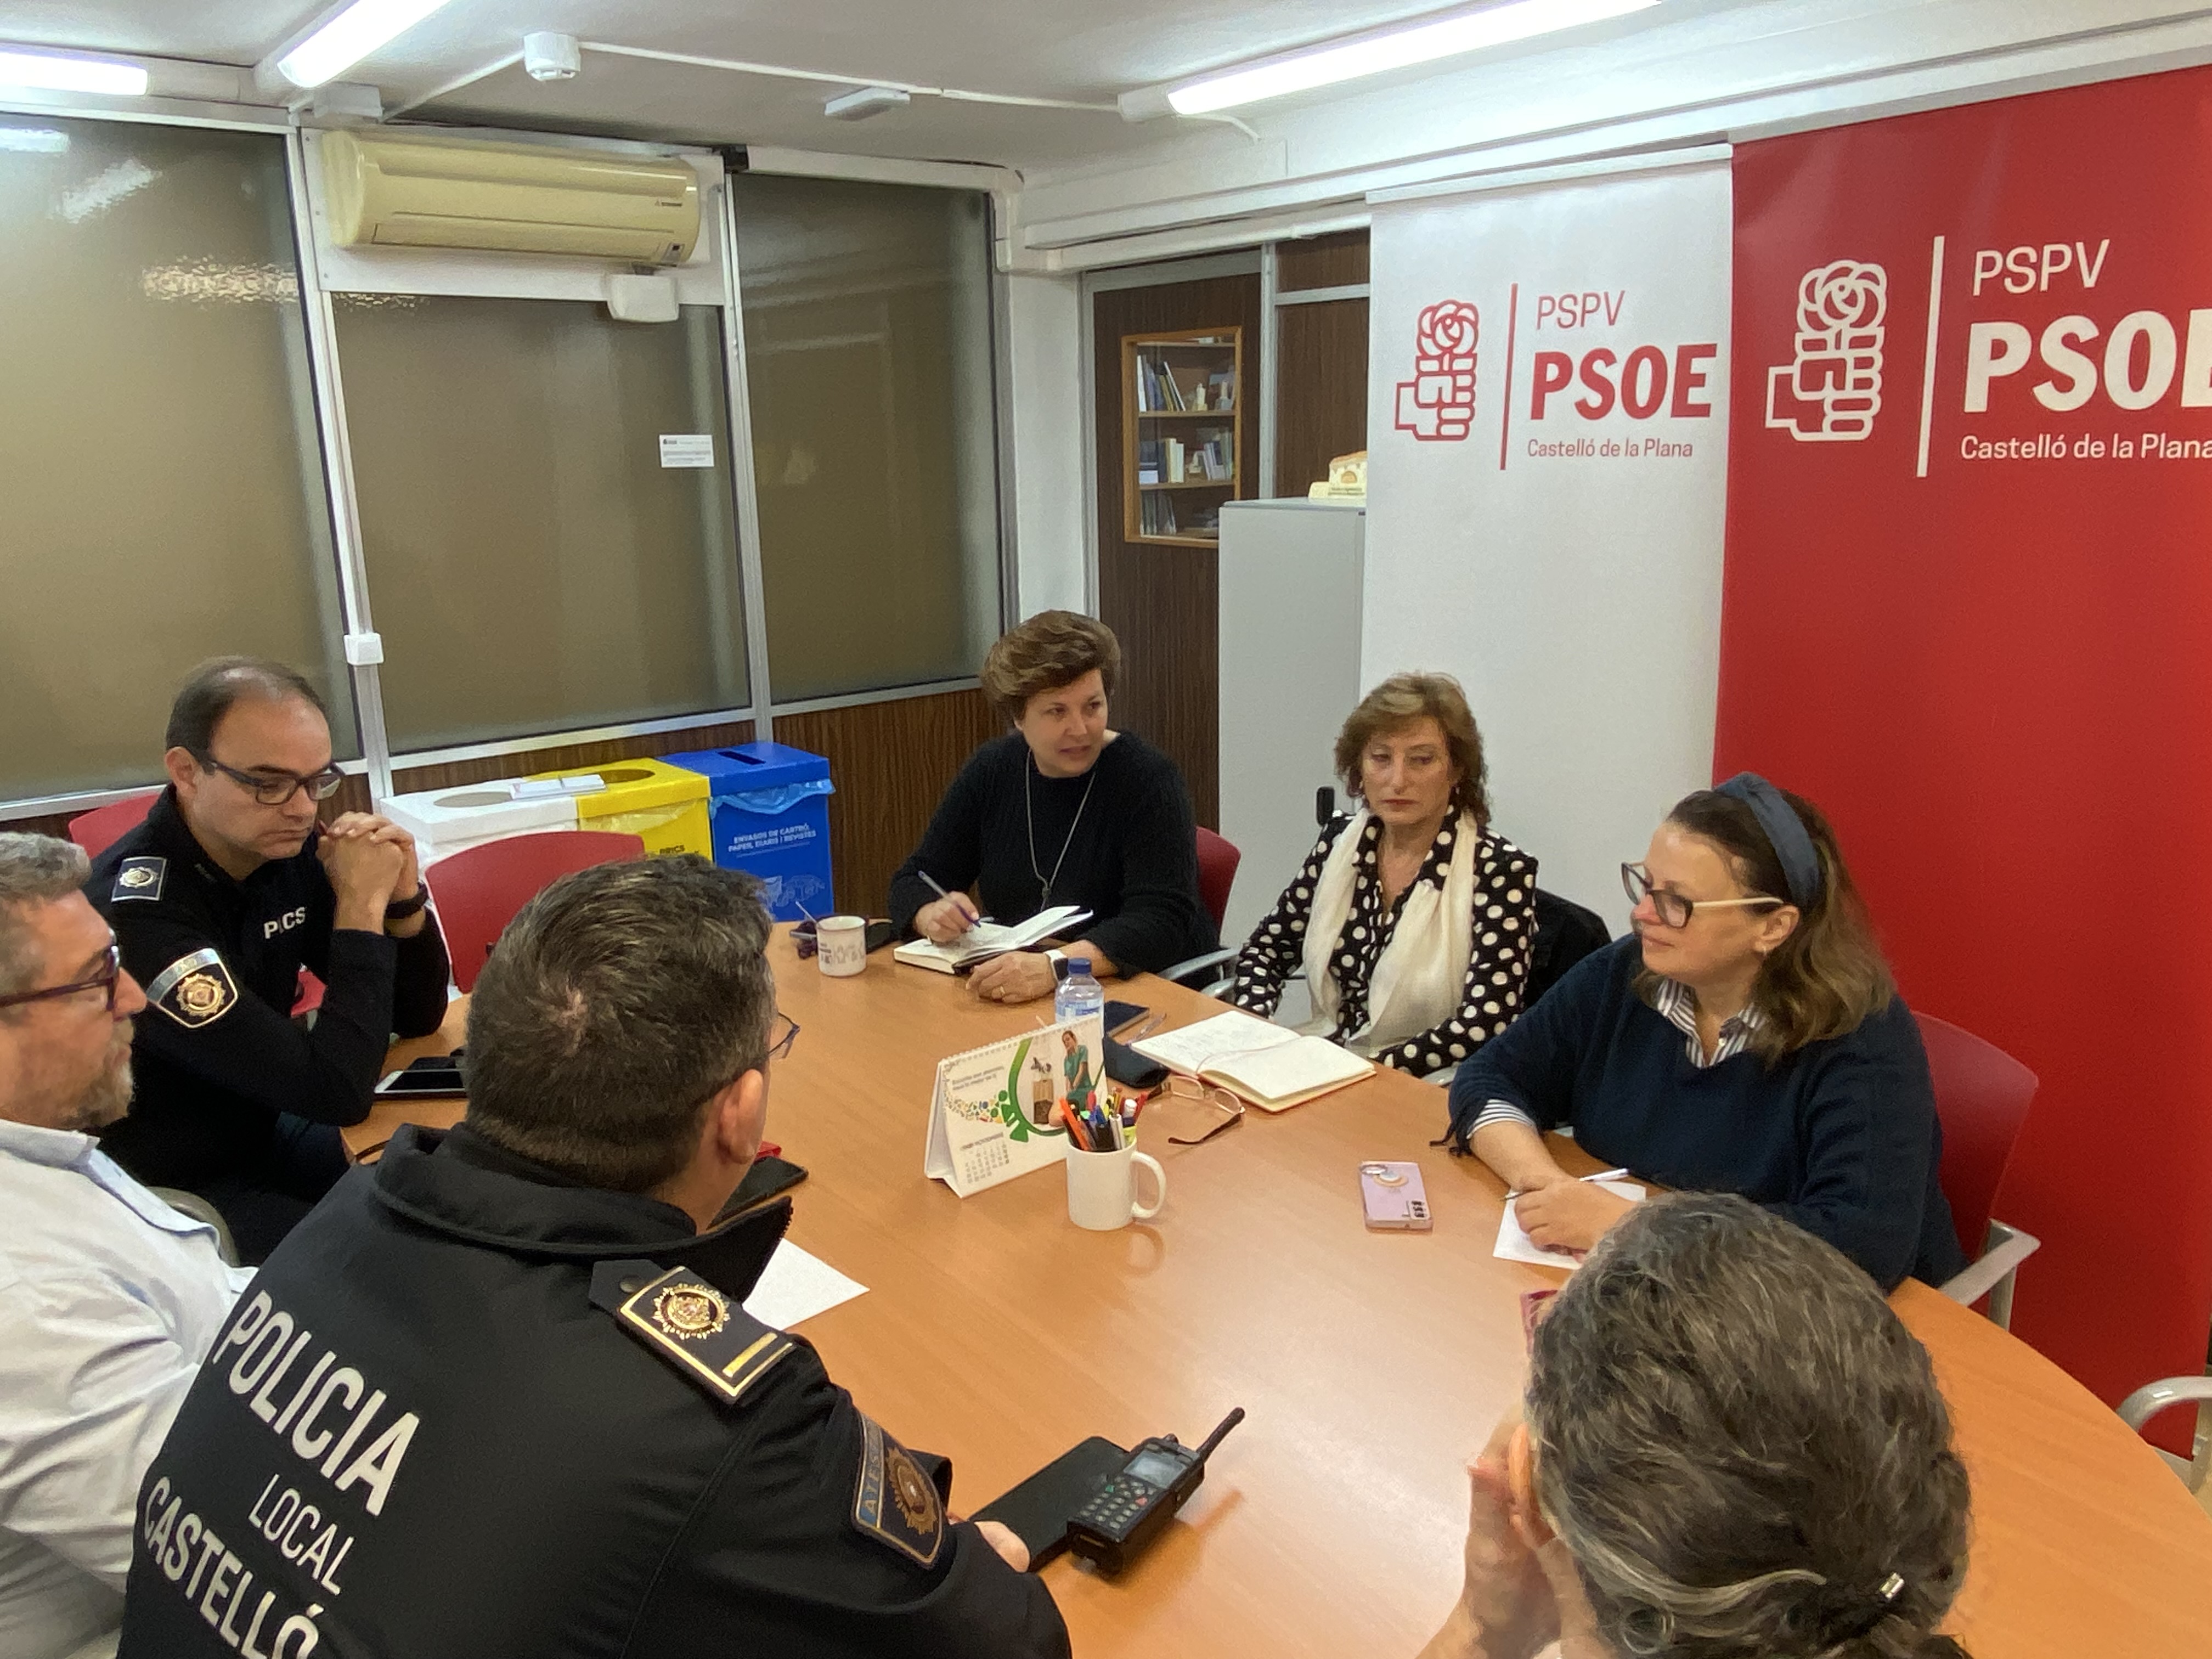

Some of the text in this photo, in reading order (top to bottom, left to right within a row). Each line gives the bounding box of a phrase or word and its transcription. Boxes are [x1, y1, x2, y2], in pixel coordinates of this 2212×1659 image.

[1973, 239, 2110, 296] PSPV
[1537, 290, 1626, 329] PSPV
[1530, 343, 1718, 421] PSOE
[1527, 438, 1694, 458] Castelló de la Plana
[1961, 432, 2212, 459] Castelló de la Plana
[213, 1290, 420, 1516] POLICIA
[249, 1474, 354, 1596] LOCAL
